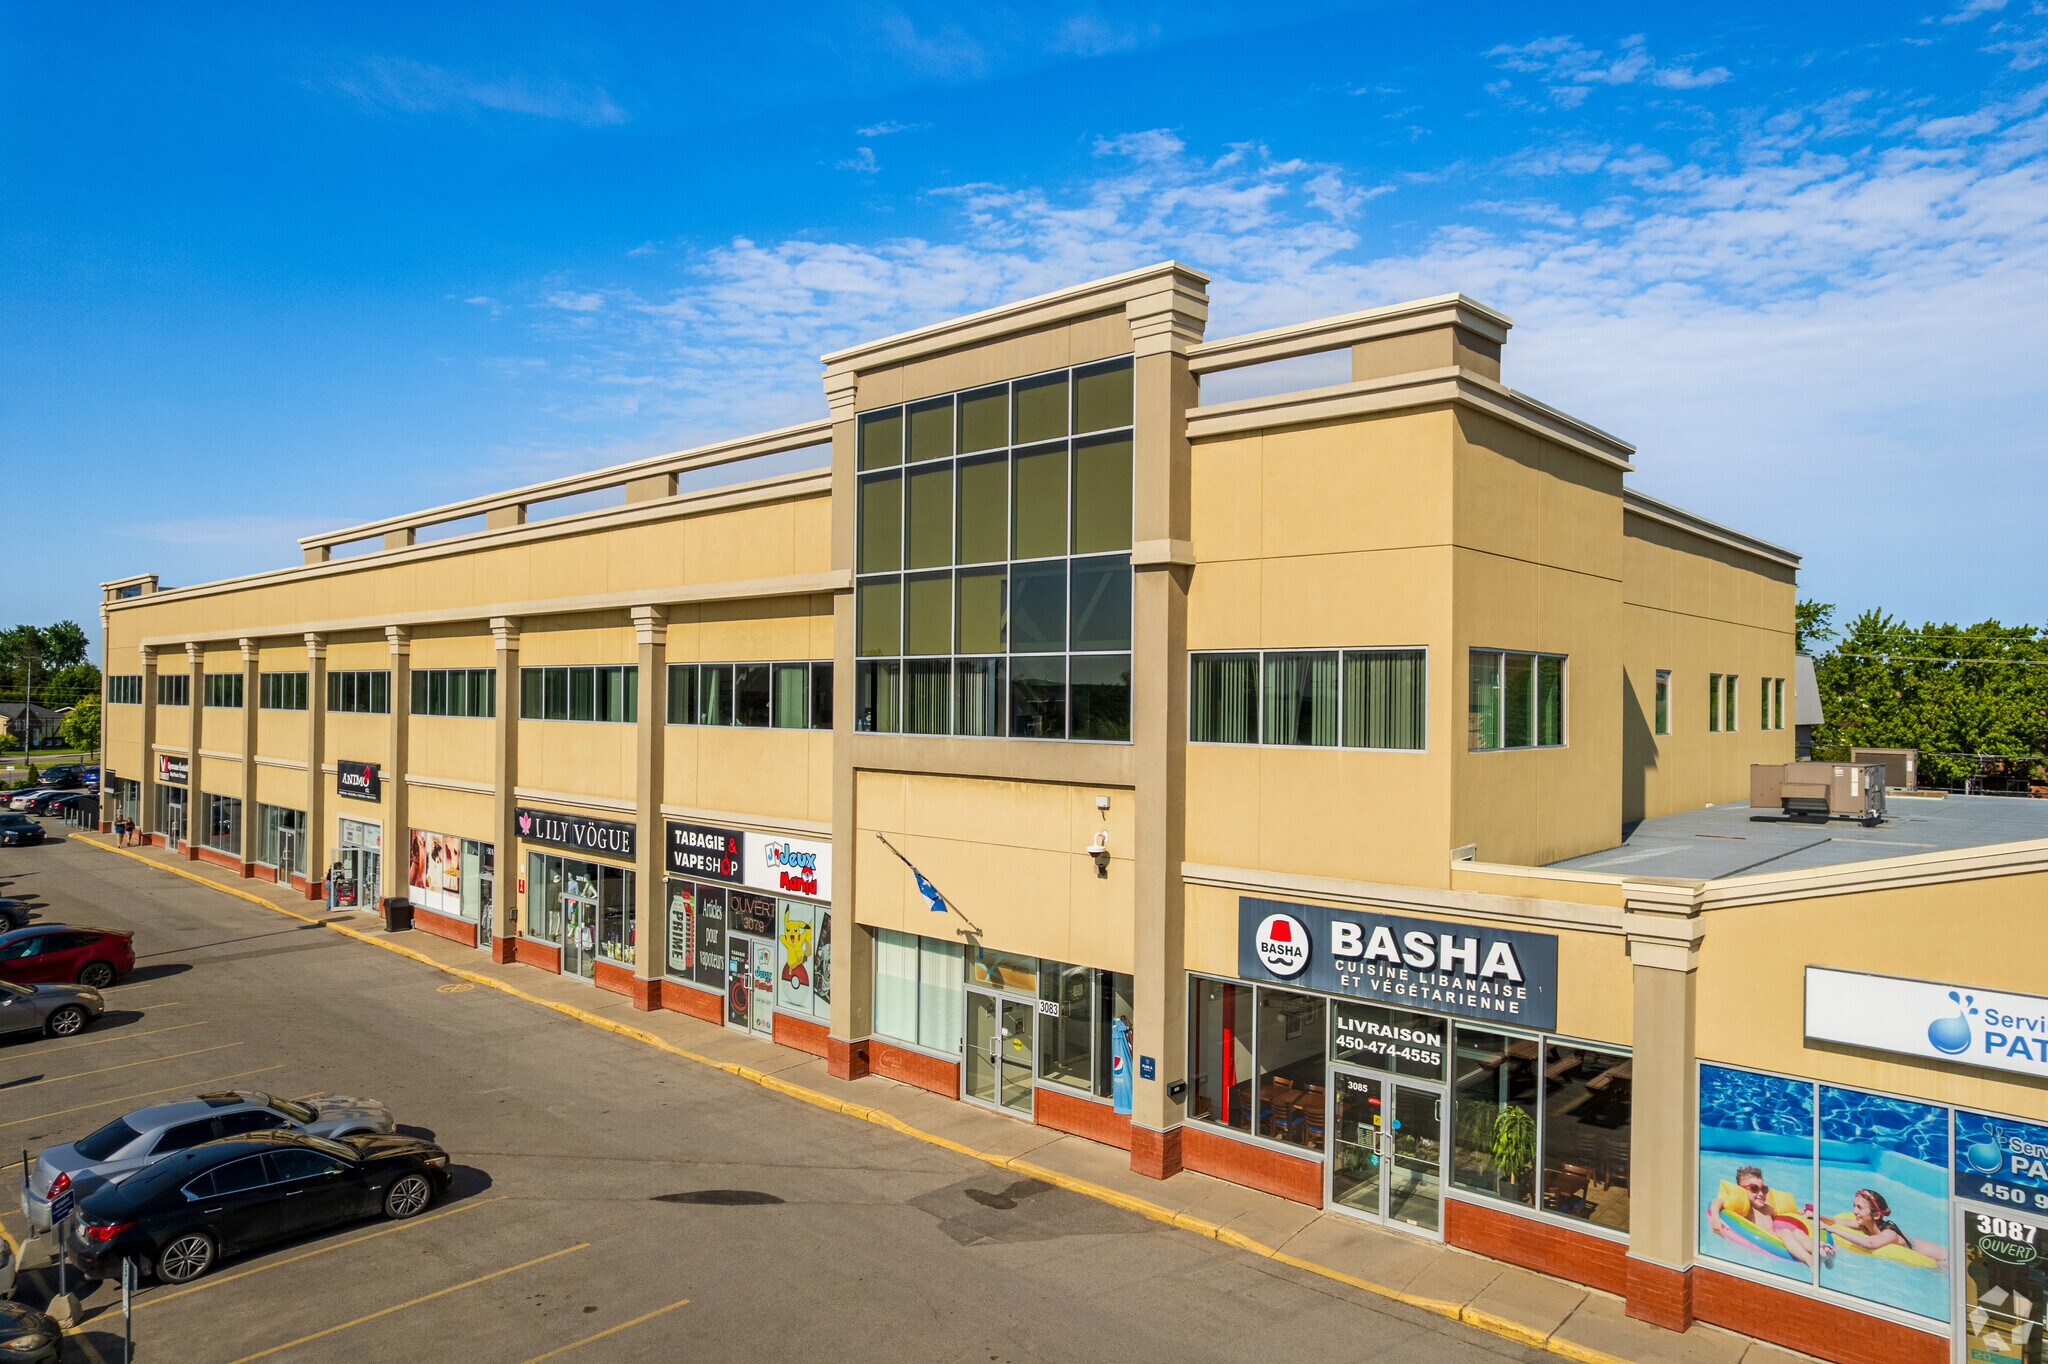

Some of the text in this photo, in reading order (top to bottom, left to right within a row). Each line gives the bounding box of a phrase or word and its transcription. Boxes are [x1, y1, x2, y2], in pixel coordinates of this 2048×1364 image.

[341, 772, 370, 788] ANIMO
[535, 818, 630, 853] LILY VÖGUE
[674, 829, 739, 855] TABAGIE &
[673, 851, 704, 870] VAPE
[779, 843, 817, 871] Jeux
[779, 870, 818, 895] Mania
[702, 898, 723, 920] Articles
[730, 896, 776, 918] OUVERT
[672, 910, 684, 960] PRIME
[705, 927, 719, 946] pour
[743, 917, 765, 933] 3079
[699, 950, 725, 971] vapoteurs
[1261, 941, 1303, 959] BASHA
[1331, 920, 1524, 983] BASHA
[1335, 960, 1527, 1001] CUISINE LIBANAISE
[1341, 974, 1521, 1014] ET VÉGÉTARIENNE
[1040, 1001, 1058, 1015] 3083
[1984, 1008, 2048, 1033] Servi
[1337, 1017, 1441, 1048] LIVRAISON
[1336, 1034, 1441, 1066] 450-474-4555
[1985, 1031, 2048, 1063] PAT
[1347, 1080, 1369, 1094] 3085
[2011, 1155, 2048, 1181] PA
[1980, 1182, 2026, 1204] 450
[1976, 1214, 2037, 1244] 3087
[1982, 1238, 2033, 1259] OUVERT
